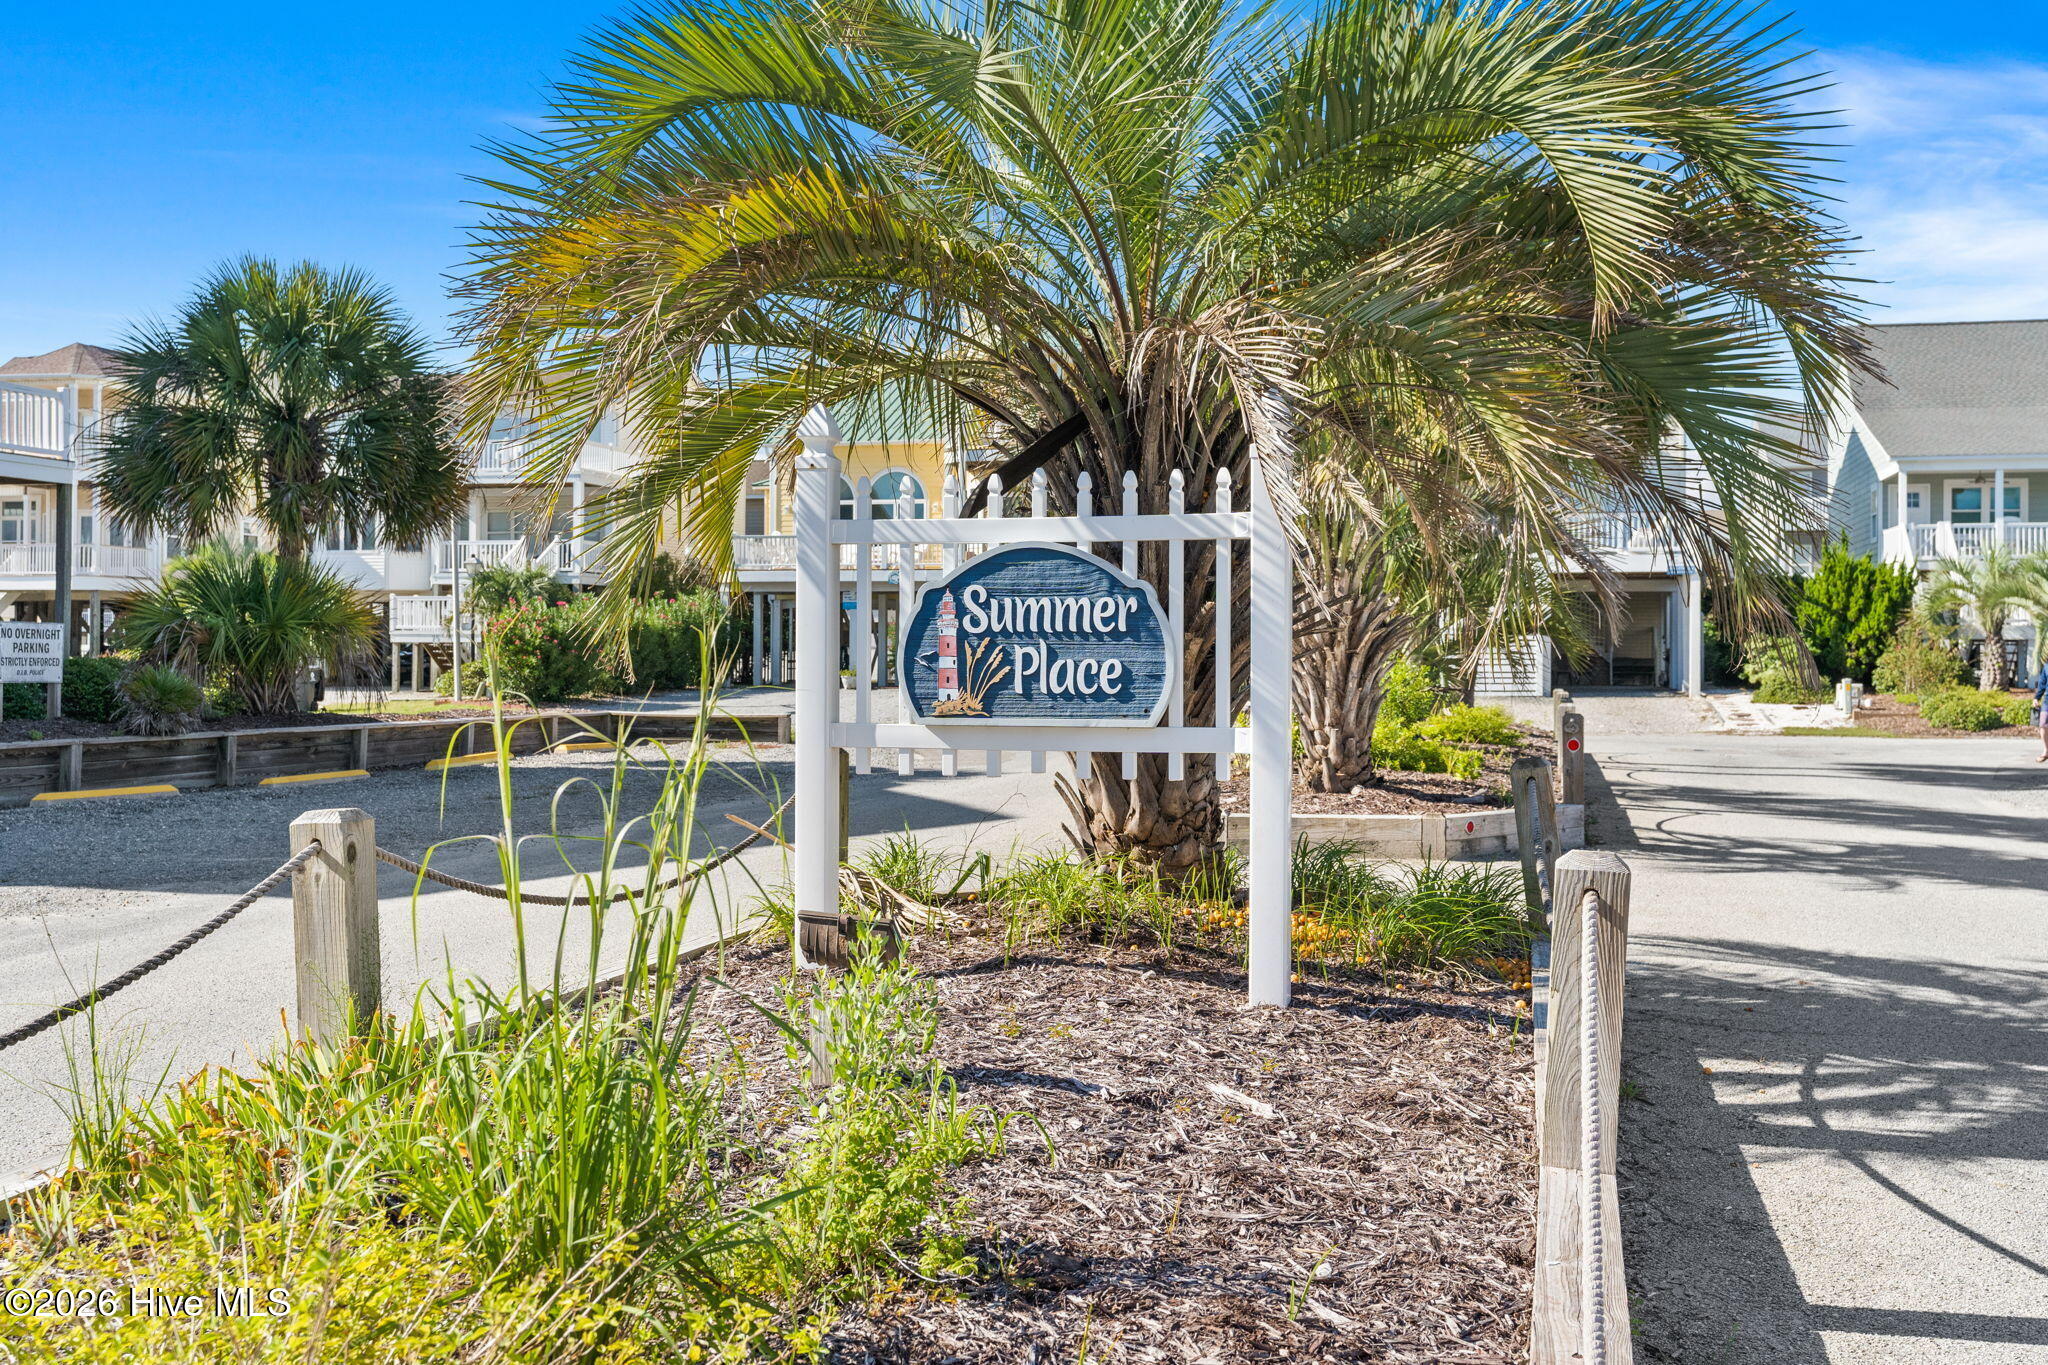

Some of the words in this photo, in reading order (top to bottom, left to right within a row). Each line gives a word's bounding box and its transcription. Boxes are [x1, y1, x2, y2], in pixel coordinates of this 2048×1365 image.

[962, 584, 1138, 634] Summer
[1, 628, 12, 638] NO
[15, 628, 60, 640] OVERNIGHT
[13, 642, 50, 653] PARKING
[0, 657, 27, 666] STRICTLY
[29, 657, 60, 666] ENFORCED
[1013, 638, 1123, 695] Place
